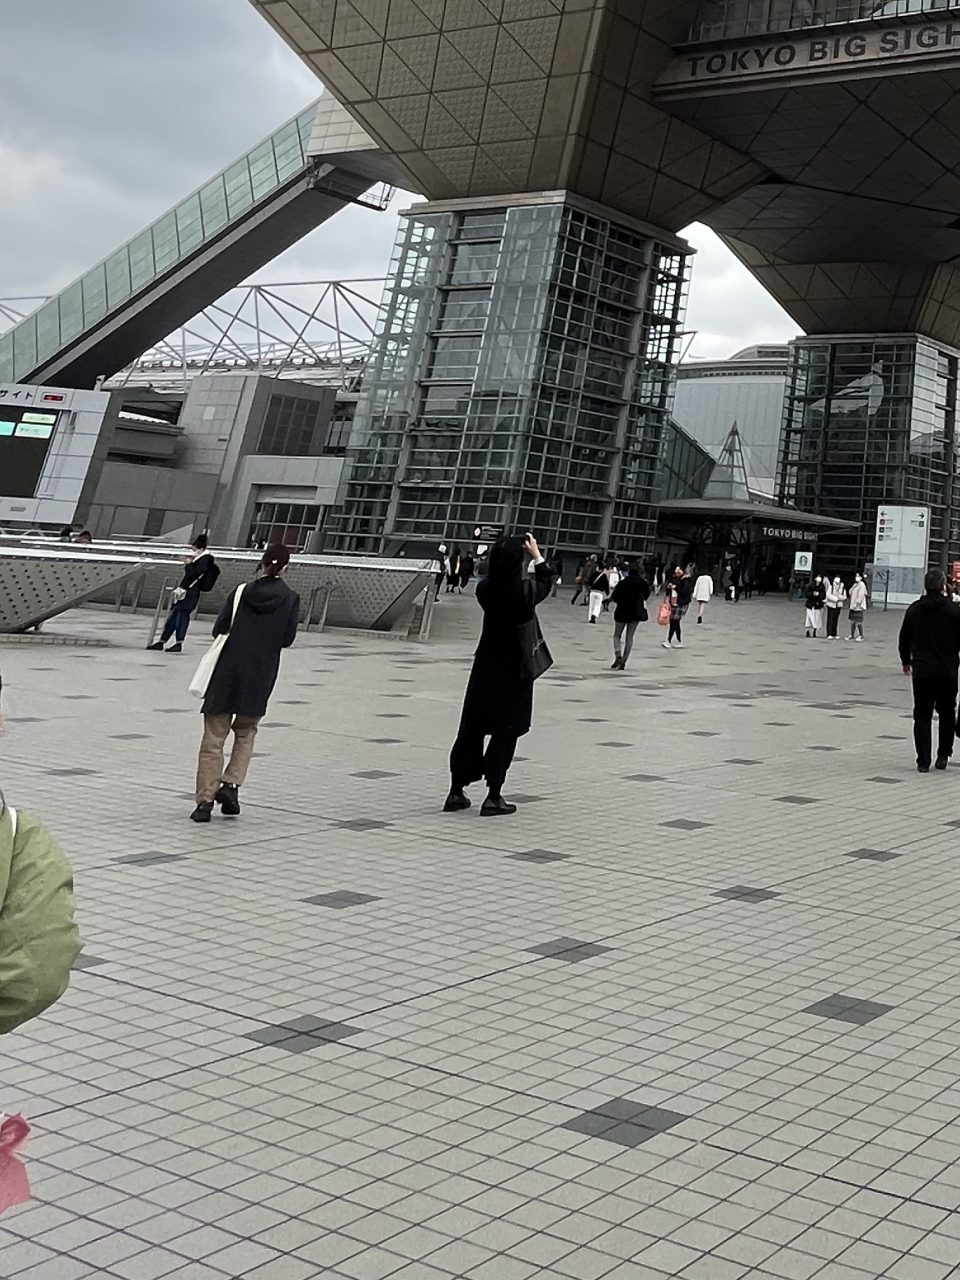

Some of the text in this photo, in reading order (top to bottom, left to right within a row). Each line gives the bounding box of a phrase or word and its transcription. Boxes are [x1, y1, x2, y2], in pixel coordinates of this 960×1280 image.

[687, 45, 796, 77] TOKYO
[808, 34, 867, 62] BIG
[762, 527, 791, 538] TOKYO
